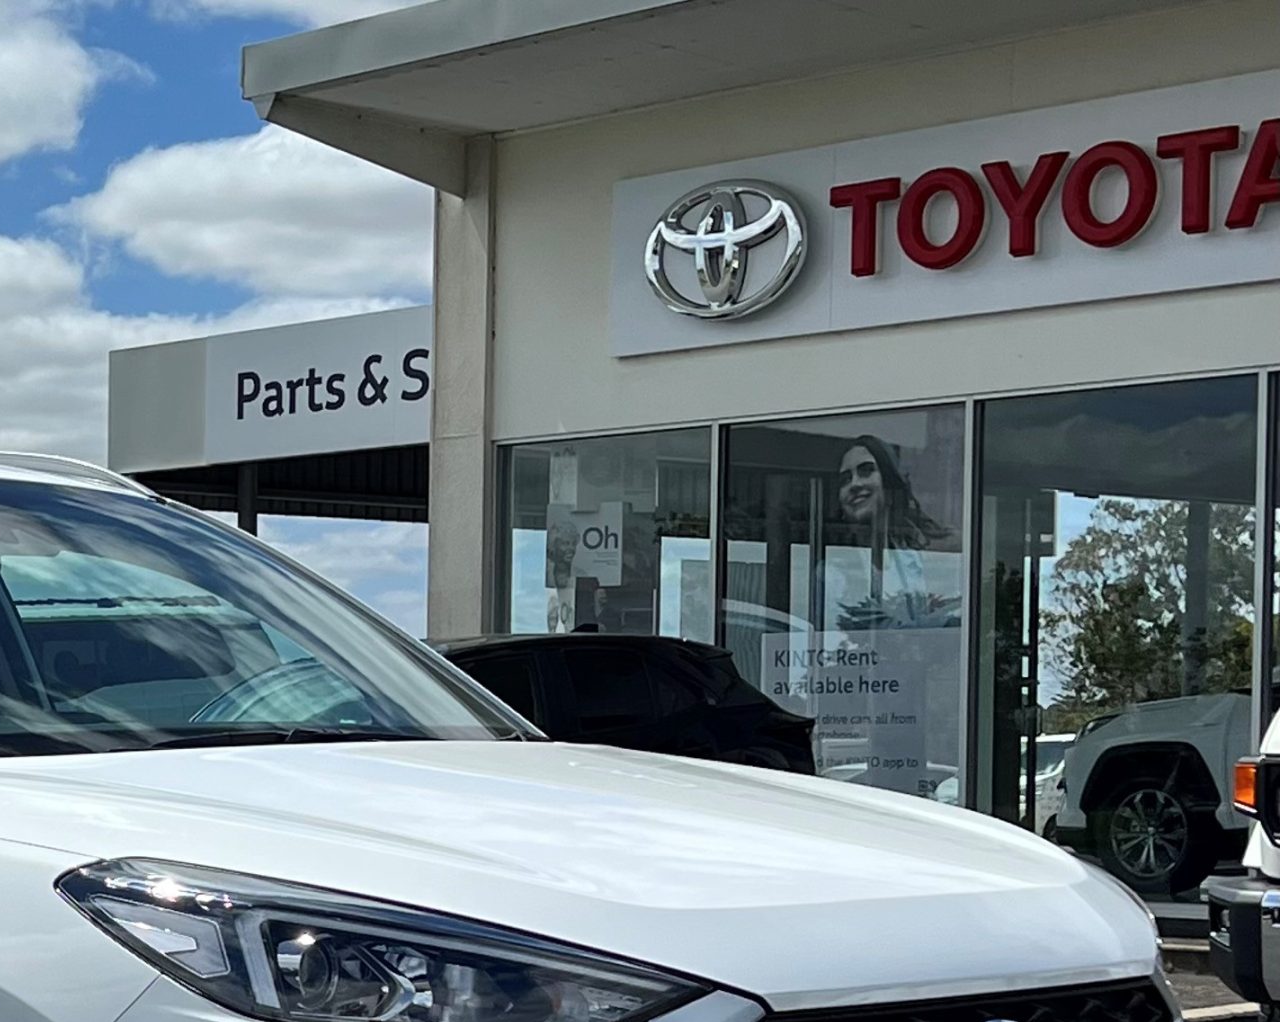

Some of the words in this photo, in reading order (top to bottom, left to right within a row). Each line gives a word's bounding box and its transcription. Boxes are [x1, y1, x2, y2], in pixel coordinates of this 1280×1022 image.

[236, 367, 346, 420] Parts
[357, 354, 389, 407] &
[582, 525, 619, 550] Oh
[836, 648, 879, 666] Rent
[773, 675, 854, 695] available
[858, 674, 900, 694] here
